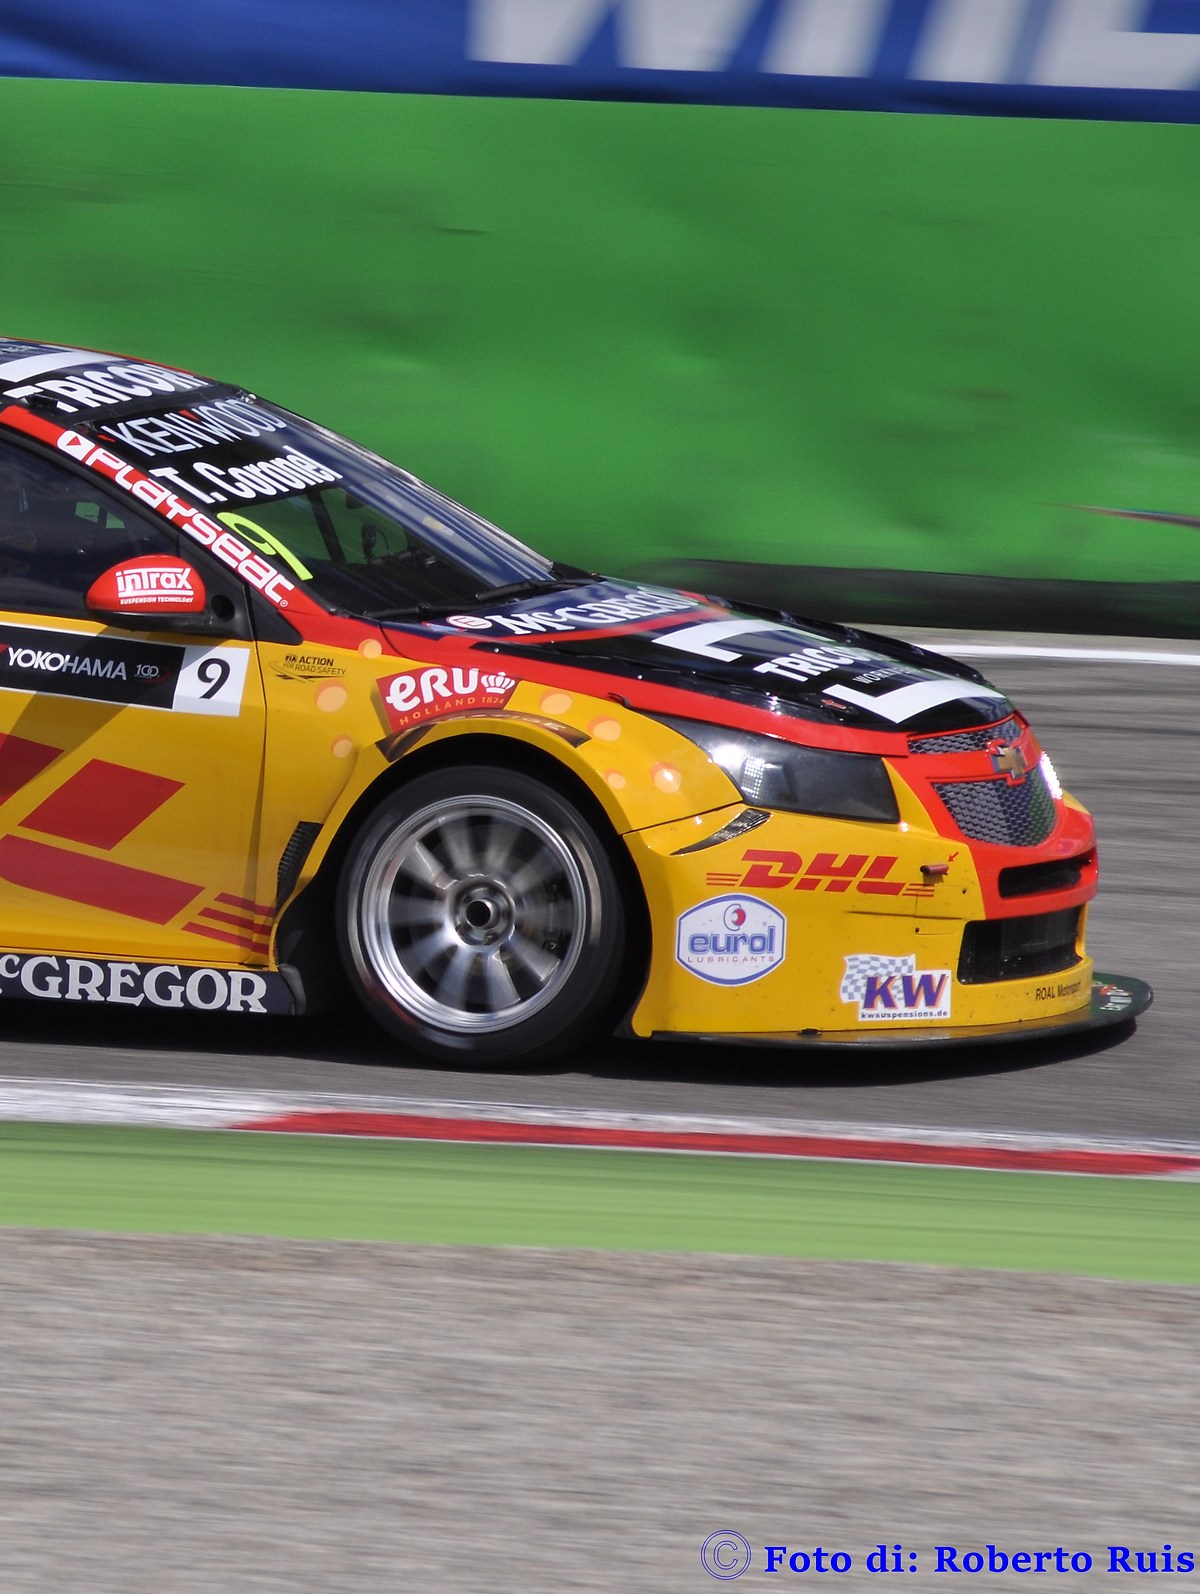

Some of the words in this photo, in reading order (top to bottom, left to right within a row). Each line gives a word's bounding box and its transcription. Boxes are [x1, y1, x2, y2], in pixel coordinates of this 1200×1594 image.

[100, 399, 288, 457] KENWOOD
[149, 466, 228, 505] T.
[193, 444, 344, 500] Coronel
[216, 510, 314, 581] 9
[7, 646, 128, 682] YOKOHAMA
[295, 665, 316, 673] ROAD
[318, 666, 347, 675] SAFETY
[298, 656, 335, 667] ACTION
[197, 657, 231, 700] 9
[399, 696, 477, 726] HOLLAND
[481, 695, 506, 705] 1824
[738, 848, 906, 897] DHL
[688, 925, 776, 955] eurol
[687, 955, 776, 963] LUBRICANTS
[863, 973, 949, 1010] KW
[1035, 987, 1056, 1001] ROAL
[861, 1010, 948, 1020] kwsuspensions.de
